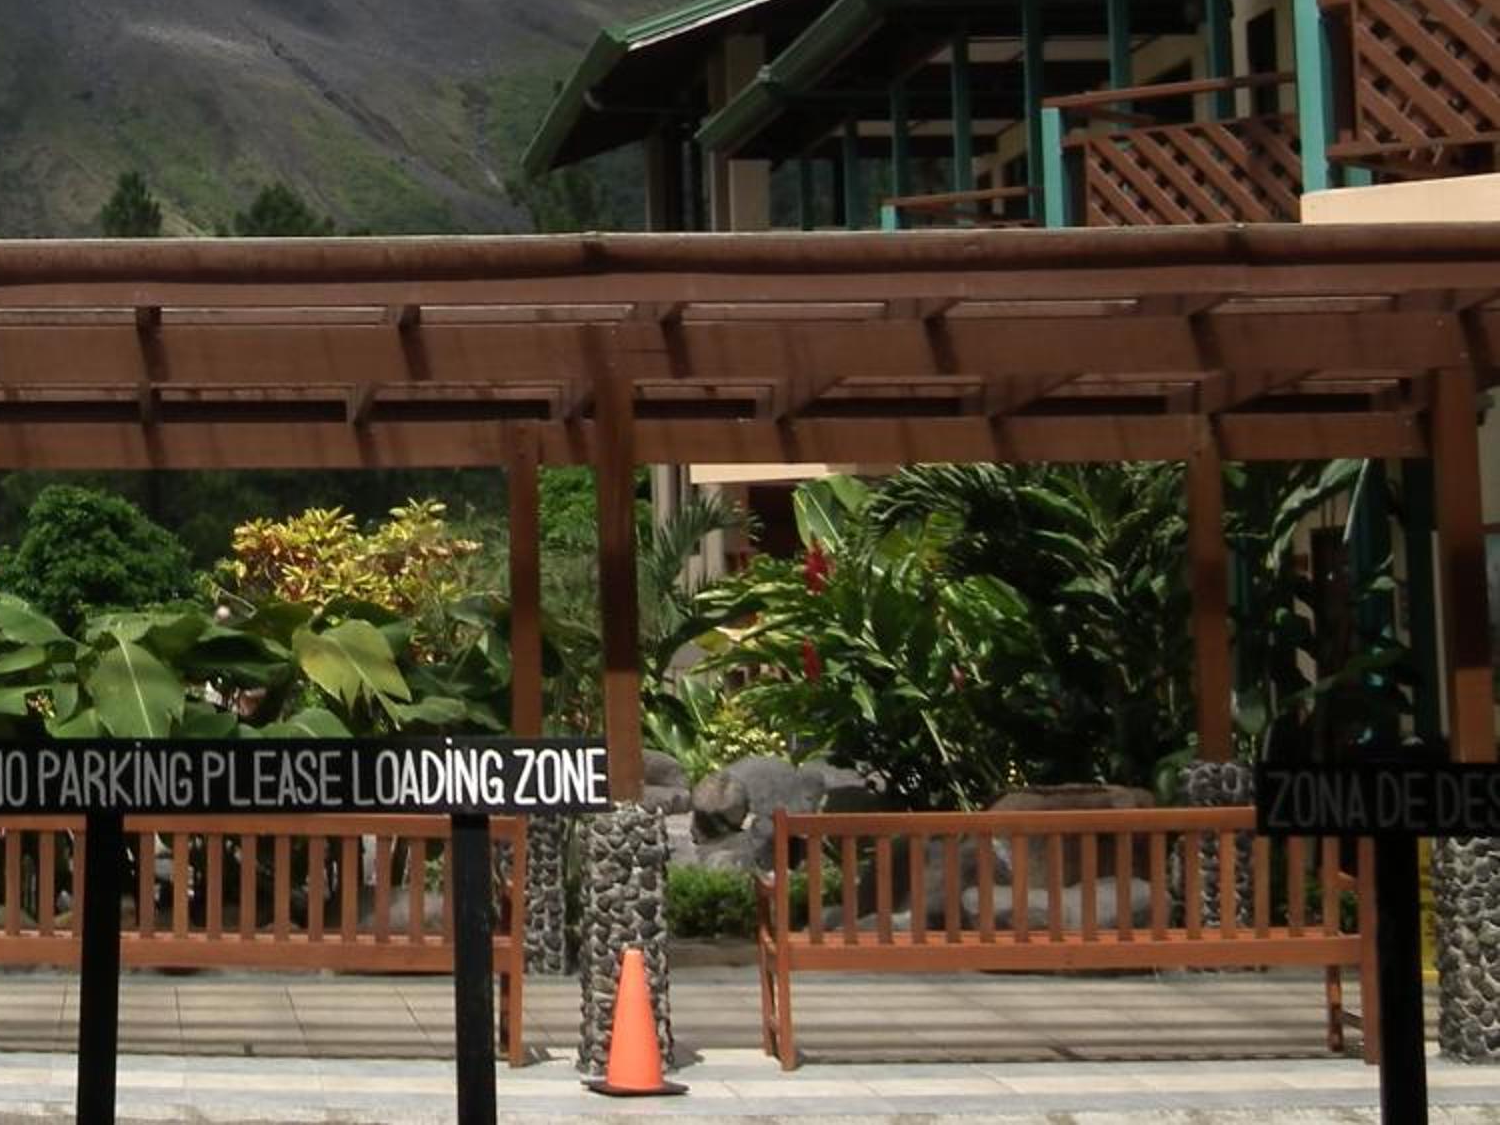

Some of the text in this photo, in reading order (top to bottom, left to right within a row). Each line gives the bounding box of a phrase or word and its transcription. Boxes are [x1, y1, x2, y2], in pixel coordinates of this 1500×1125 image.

[202, 749, 342, 806] PLEASE
[512, 748, 608, 806] ZONE
[1266, 770, 1368, 828] ZONA
[1376, 770, 1429, 828] DE
